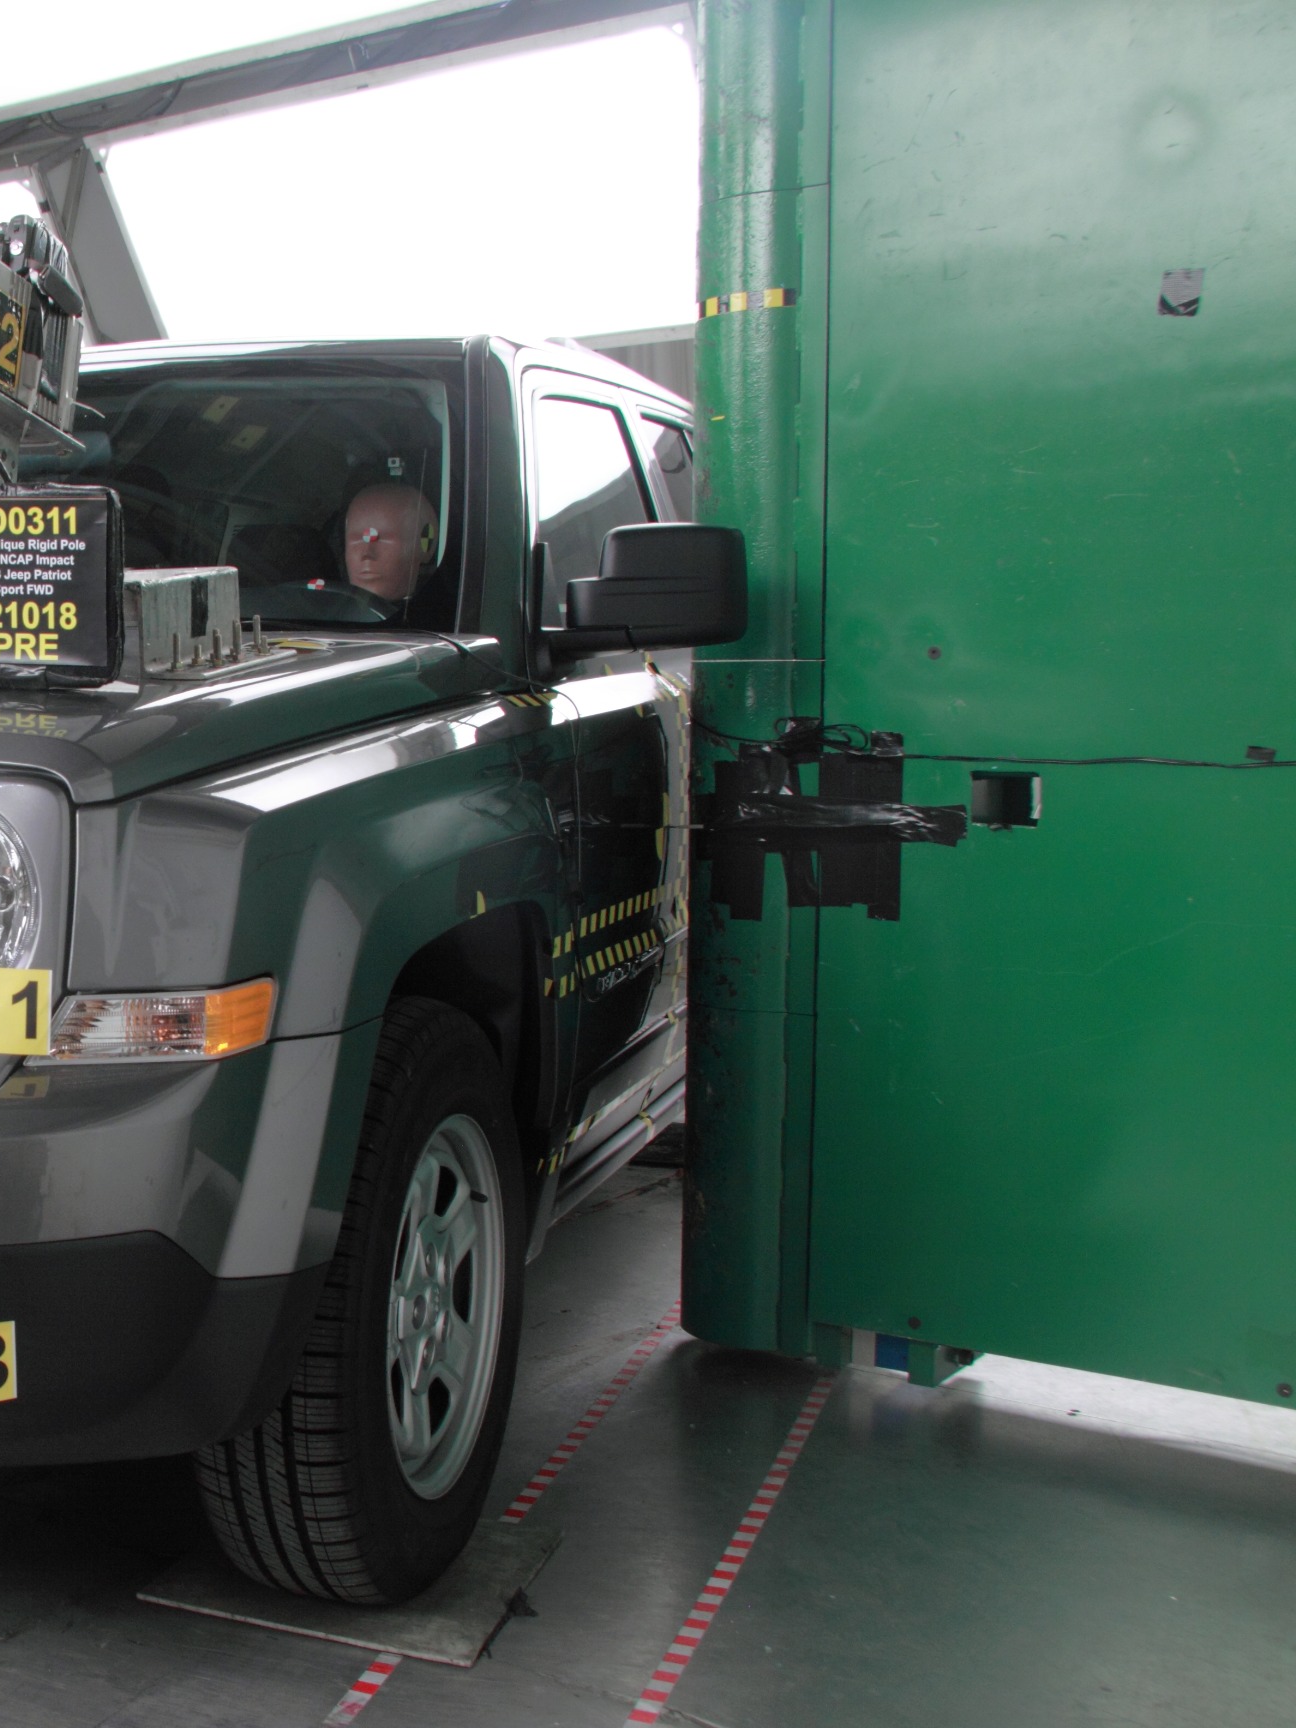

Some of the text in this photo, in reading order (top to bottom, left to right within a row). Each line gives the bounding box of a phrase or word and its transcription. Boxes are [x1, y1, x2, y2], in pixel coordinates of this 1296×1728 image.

[28, 539, 57, 553] Rigid
[60, 539, 86, 551] Pole
[0, 554, 33, 565] NCAP
[36, 554, 75, 567] Impact
[4, 569, 31, 582] Jeep
[34, 569, 72, 581] Patriot
[26, 584, 54, 595] FWD
